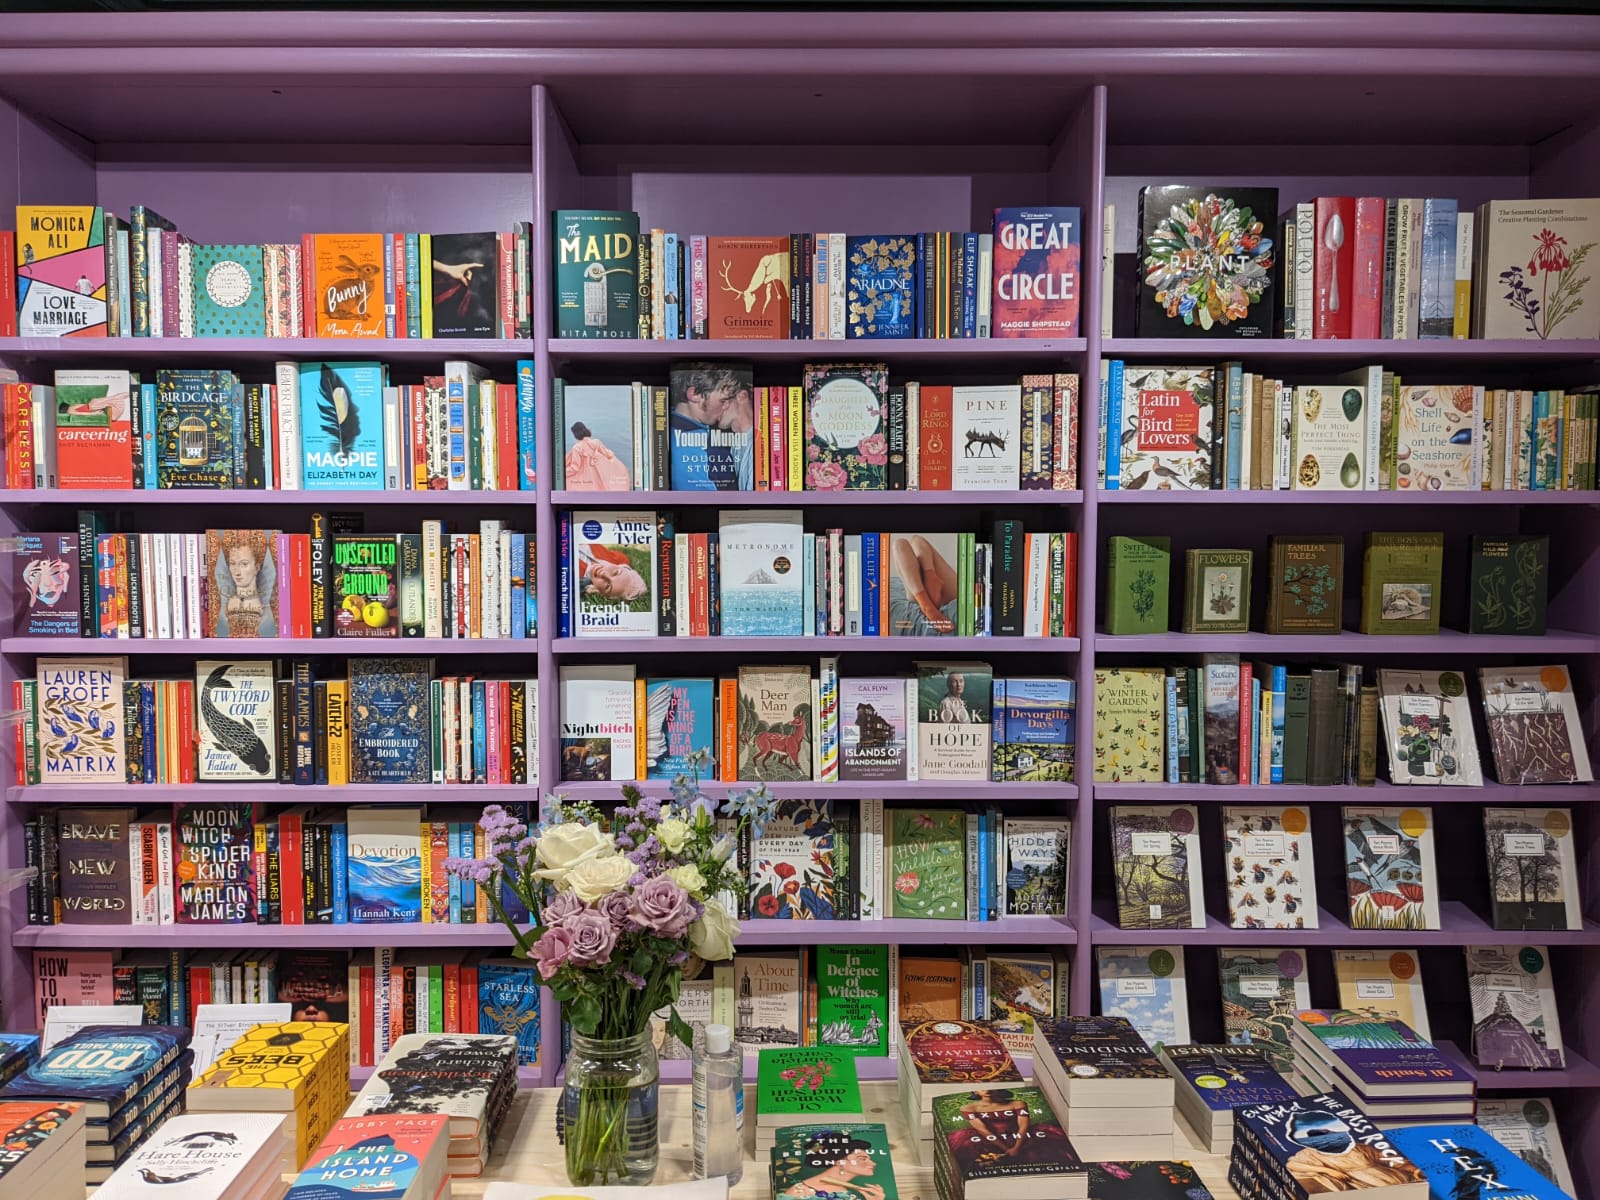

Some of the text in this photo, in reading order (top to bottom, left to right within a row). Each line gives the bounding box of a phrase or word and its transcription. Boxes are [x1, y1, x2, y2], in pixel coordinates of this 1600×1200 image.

[30, 216, 85, 232] MONICA
[566, 224, 582, 237] The
[48, 234, 68, 248] ALI
[1001, 222, 1073, 250] GREAT
[1298, 209, 1313, 274] POLPO
[560, 233, 633, 264] MAID
[967, 237, 975, 289] ELIF SHAFAK
[1169, 255, 1250, 271] PLANT
[694, 240, 703, 316] THIS ONE SKY DAY
[855, 278, 910, 290] ARIADNE
[1398, 258, 1407, 304] VEGETABLES
[998, 273, 1074, 300] CIRCLE
[43, 296, 76, 310] LOVE
[327, 280, 367, 315] Bunny
[1398, 305, 1404, 313] IN
[33, 311, 88, 325] MARRIAGE
[723, 316, 774, 327] Grimoire
[161, 392, 226, 403] BIRDCAGE
[1142, 393, 1180, 407] Latin
[655, 391, 666, 431] Shuggie Bain
[966, 400, 1008, 412] PINE
[415, 391, 424, 444] exciting times
[1416, 408, 1442, 418] Shell
[17, 384, 29, 469] CARELESS
[1141, 419, 1172, 432] Bird
[1421, 423, 1441, 432] Life
[58, 429, 128, 443] careering
[674, 429, 747, 450] Young Mungo
[1140, 432, 1190, 445] Lovers
[1412, 437, 1447, 447] on the
[306, 452, 377, 467] MAGPIE
[682, 455, 741, 463] DOUGLAS
[1412, 450, 1463, 461] Seashore
[687, 465, 735, 473] STUART
[171, 473, 218, 482] Eve Chase
[613, 520, 650, 532] Anne
[614, 532, 652, 545] Tyler
[1004, 520, 1013, 572] To Paradise
[335, 543, 395, 565] UNSETTLED
[1199, 555, 1248, 564] FLOWERS
[1288, 552, 1316, 560] TREES
[312, 543, 322, 584] FOLEY
[661, 540, 672, 597] Reputation
[343, 574, 387, 595] GROUND
[130, 573, 139, 624] LUCKENBOOTH
[580, 601, 630, 612] French
[45, 620, 70, 629] Dangers
[581, 614, 619, 626] Braid
[337, 627, 391, 636] Claire Fuller
[44, 670, 112, 685] LAUREN
[1211, 670, 1237, 679] Scotland
[46, 687, 110, 702] GROFF
[212, 690, 270, 702] TWYFORD
[297, 663, 310, 727] THE FLAMES
[673, 688, 688, 698] MY
[760, 689, 790, 700] Deer
[1107, 689, 1148, 698] WINTER
[671, 699, 690, 708] PEN
[761, 701, 788, 711] Man
[1108, 697, 1148, 705] GARDEN
[229, 704, 257, 716] CODE
[329, 693, 342, 738] CATCH-22
[928, 709, 983, 723] BOOK
[1010, 708, 1070, 720] Devorgilla
[563, 724, 633, 736] Nightbitch
[667, 722, 694, 732] WING
[1028, 719, 1054, 729] Days
[359, 738, 419, 748] EMBROIDERED
[929, 733, 982, 747] HOPE
[205, 750, 231, 761] Janice
[377, 749, 400, 758] BOOK
[845, 748, 901, 757] ISLANDS OF
[47, 756, 116, 772] MATRIX
[207, 760, 238, 771] Hallett
[193, 810, 239, 826] MOON
[182, 828, 231, 844] WITCH
[143, 827, 153, 885] SCABBY QUEEN
[190, 846, 250, 863] SPIDER
[351, 844, 417, 857] Devotion
[69, 859, 116, 875] NEW
[198, 863, 237, 879] KING
[270, 851, 279, 900] THE LIARS
[181, 887, 248, 904] MARLON
[63, 897, 125, 911] WORLD
[1010, 902, 1061, 911] MOFFAT
[191, 903, 246, 920] JAMES
[353, 909, 415, 918] Hannah Kent
[846, 954, 860, 966] In
[39, 958, 68, 977] HOW
[382, 949, 390, 987] CLEOPATRA
[755, 963, 796, 976] About
[827, 965, 879, 976] Defence
[40, 978, 57, 997] TO
[484, 982, 535, 993] STARLESS
[755, 978, 789, 992] Time
[500, 993, 519, 1002] SEA
[827, 985, 878, 999] Witches
[404, 968, 415, 1031] CIRCE
[382, 1003, 390, 1053] FRANKENSTEIN
[1058, 1046, 1148, 1055] BINDING
[1171, 1048, 1256, 1056] PIRANESI
[48, 1050, 144, 1070] POD
[227, 1055, 303, 1067] BEES
[435, 1058, 499, 1067] Richard
[951, 1108, 1044, 1122] MEXICAN
[338, 1119, 440, 1131] LIBBY PAGE
[970, 1131, 1046, 1143] GOTHIC
[136, 1150, 242, 1161] Hare House
[357, 1145, 387, 1153] THE
[783, 1149, 887, 1158] BEAUTIFUL
[320, 1153, 409, 1168] ISLAND
[320, 1166, 392, 1181] HOME
